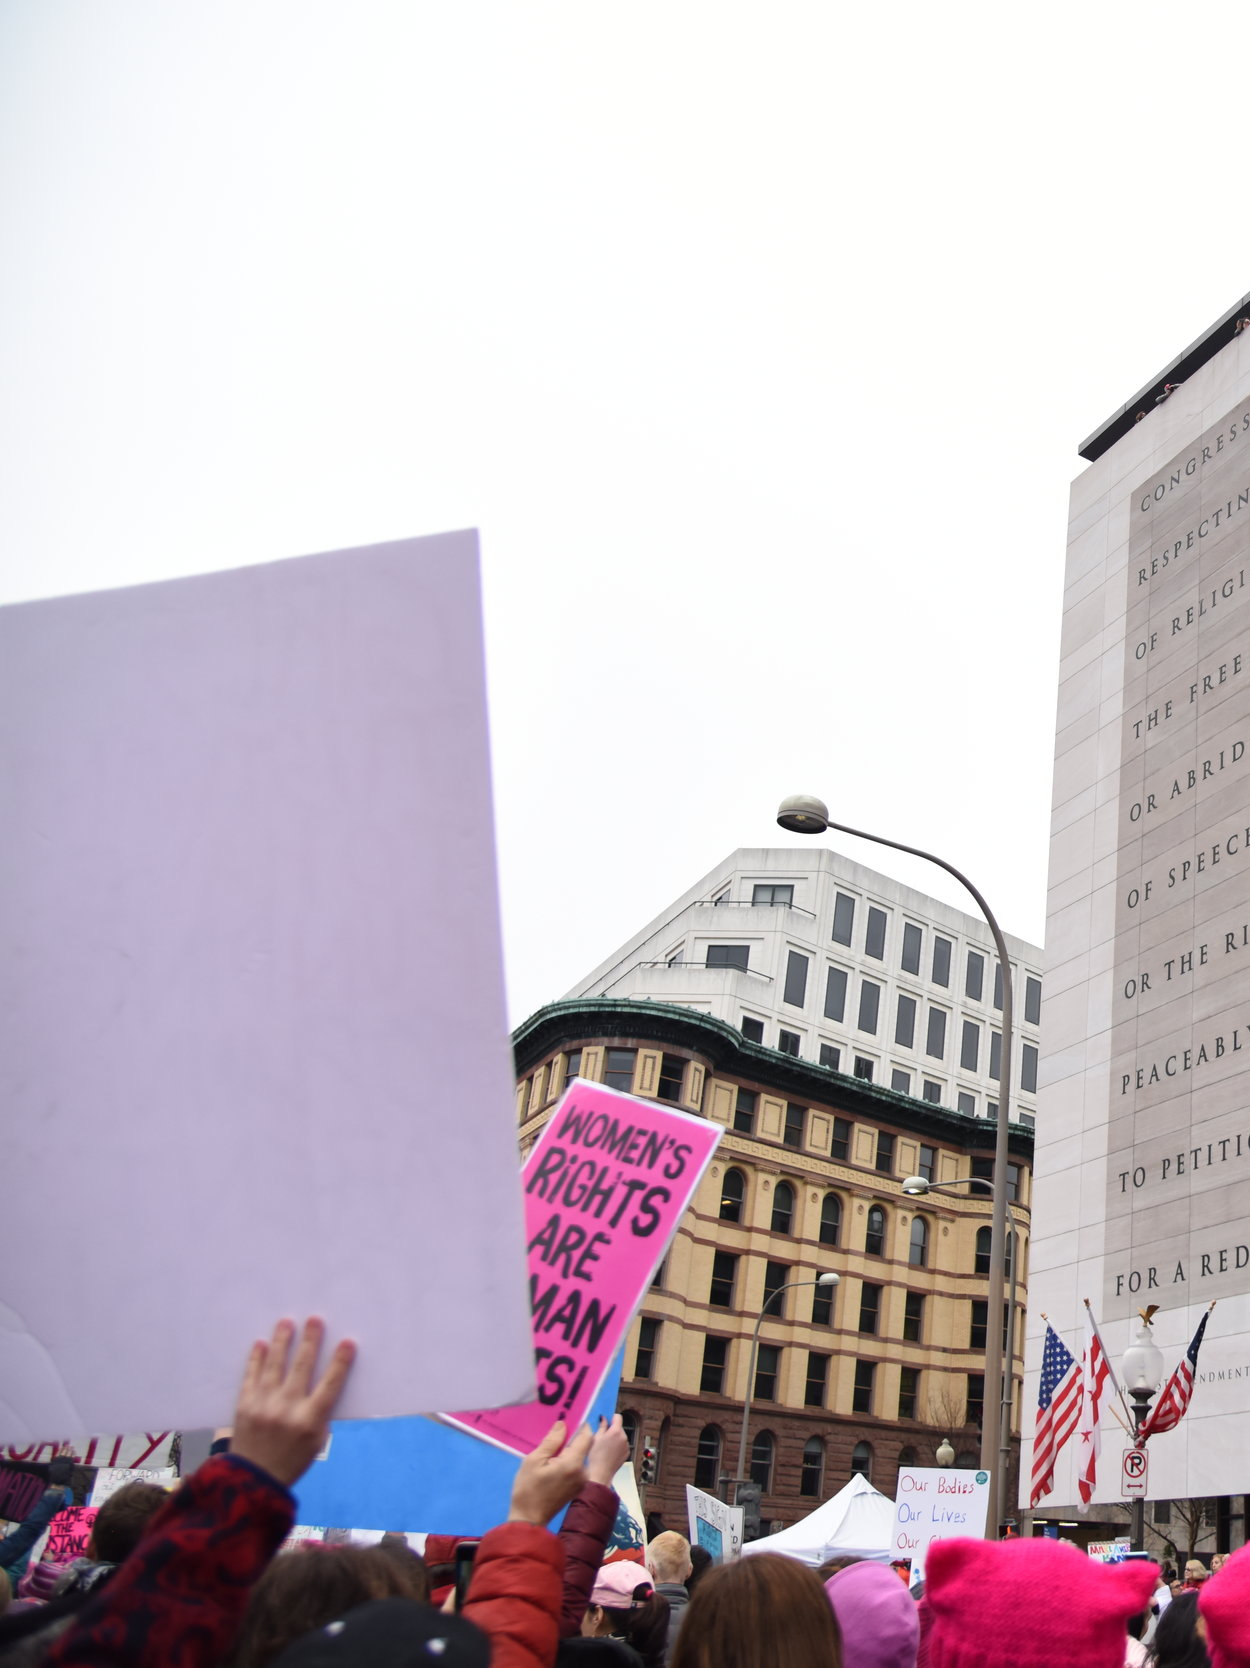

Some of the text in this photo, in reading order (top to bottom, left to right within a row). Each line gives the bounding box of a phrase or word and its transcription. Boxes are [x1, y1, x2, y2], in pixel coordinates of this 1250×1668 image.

[1139, 416, 1250, 513] CONGRESS
[1134, 631, 1158, 661] OF
[1131, 699, 1173, 740] THE
[1188, 653, 1242, 705] FREE
[1128, 792, 1158, 823] OR
[1126, 879, 1153, 910] OF
[1123, 971, 1152, 1001] OR
[1162, 942, 1208, 982] THE
[556, 1105, 693, 1179] WOMEN'S
[1117, 1165, 1146, 1194] TO
[527, 1213, 612, 1281] ARE
[1114, 1265, 1160, 1298] FOR
[1171, 1259, 1186, 1285] A
[530, 1274, 617, 1354] MAN
[1194, 1365, 1250, 1383] NDMENT
[900, 1475, 975, 1494] Our Bodies
[897, 1502, 967, 1524] Our Lives
[896, 1532, 921, 1550] Our
